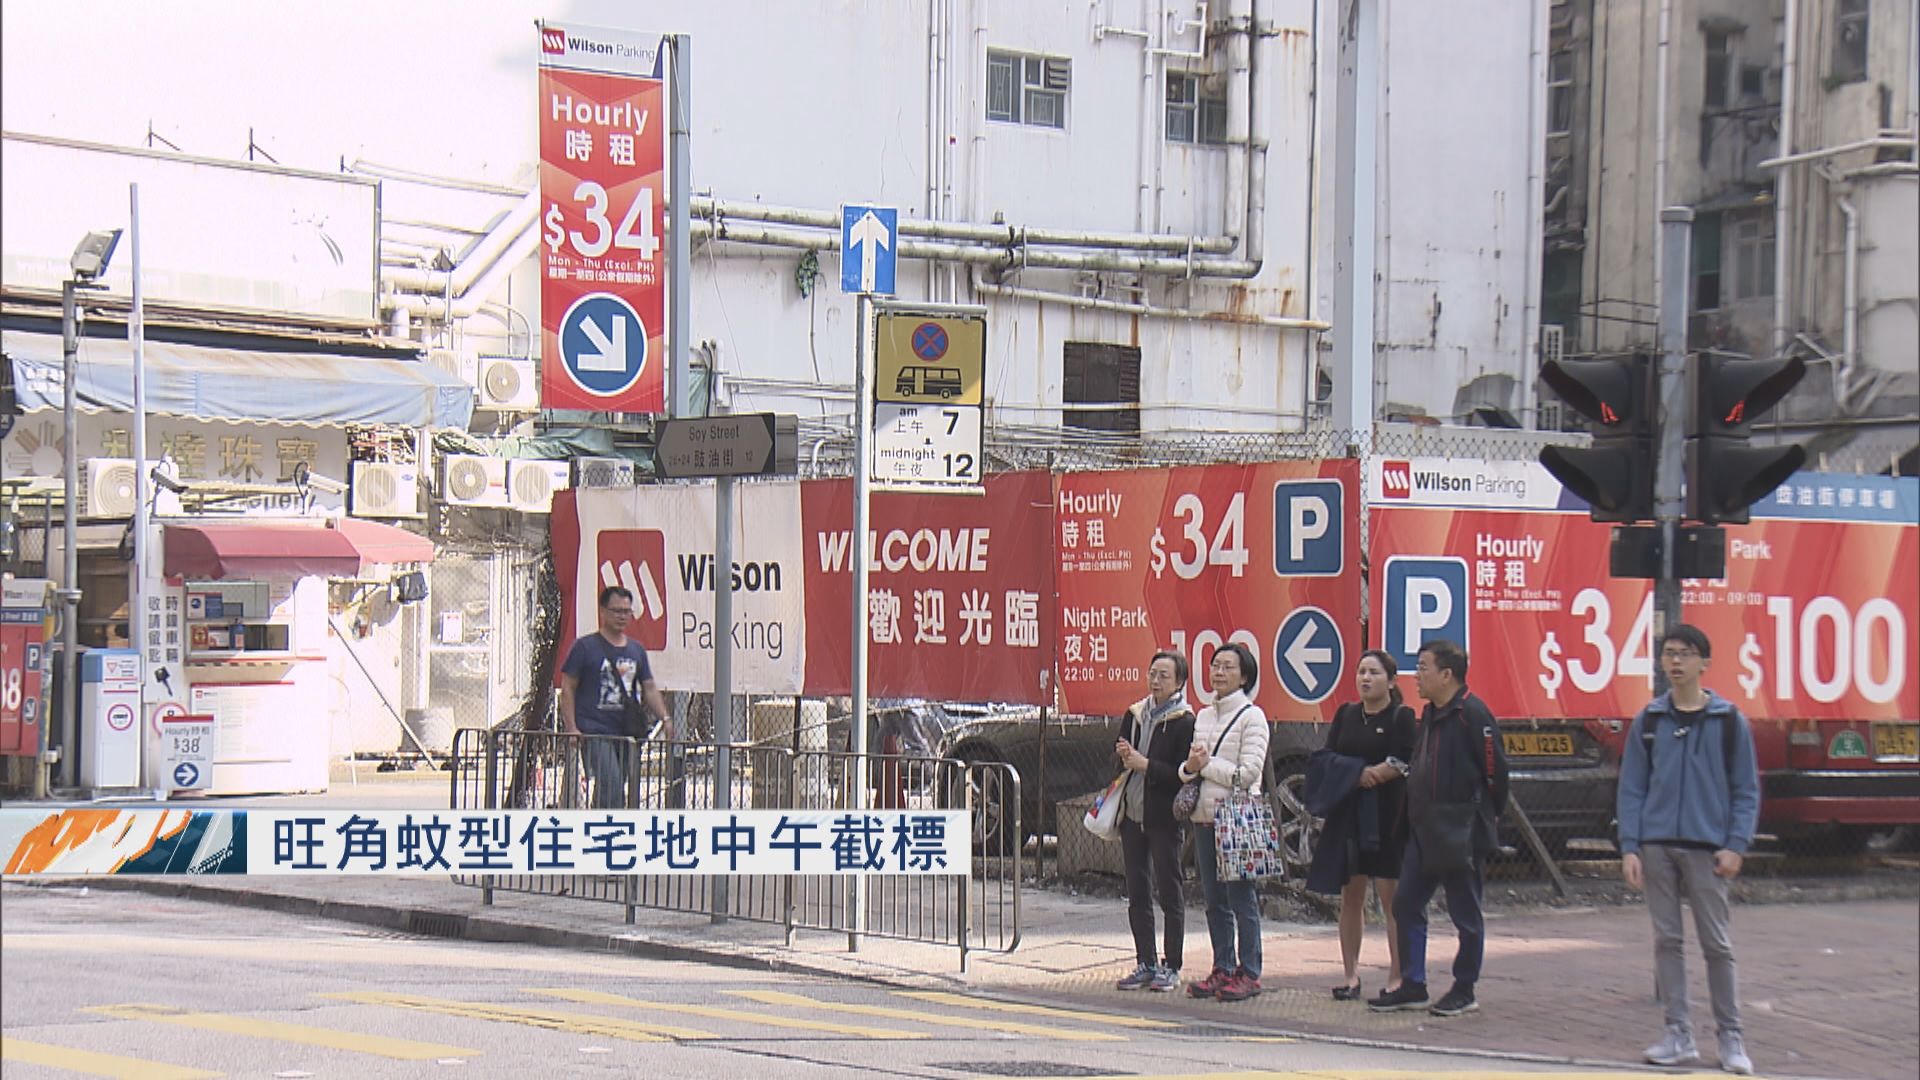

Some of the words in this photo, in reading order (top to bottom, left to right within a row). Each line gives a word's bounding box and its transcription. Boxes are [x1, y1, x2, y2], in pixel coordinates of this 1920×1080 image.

[568, 37, 613, 55] Wilson
[616, 44, 655, 63] Parking
[552, 94, 648, 136] Hourly
[565, 130, 636, 166] 時租
[543, 181, 660, 261] $34
[548, 256, 571, 266] Mon
[583, 258, 601, 269] Thu
[899, 407, 918, 417] am
[942, 410, 959, 435] 7
[689, 426, 707, 443] Soy
[710, 424, 740, 440] Street
[894, 419, 924, 435] 上午
[881, 446, 935, 460] midnight
[942, 453, 974, 478] 12
[894, 462, 923, 477] 午夜
[1414, 472, 1471, 492] Wilson
[1475, 474, 1526, 498] Parking
[1060, 488, 1122, 518] Hourly
[1061, 519, 1106, 548] 時租
[1290, 496, 1329, 561] P
[817, 528, 991, 573] WLCOME
[1476, 533, 1544, 563] Hourly
[1730, 539, 1772, 560] Park
[678, 553, 782, 592] Wison
[868, 587, 1040, 648] 歡迎光臨
[1063, 607, 1106, 632] Night
[1111, 606, 1148, 628] Park
[1404, 576, 1453, 655] P
[681, 611, 784, 660] Paking
[1064, 634, 1107, 662] 夜泊
[1737, 596, 1907, 703] $100
[1064, 667, 1095, 682] 22:00
[1108, 667, 1139, 682] 09:00
[1508, 737, 1527, 753] AJ
[1537, 737, 1569, 753] 1225
